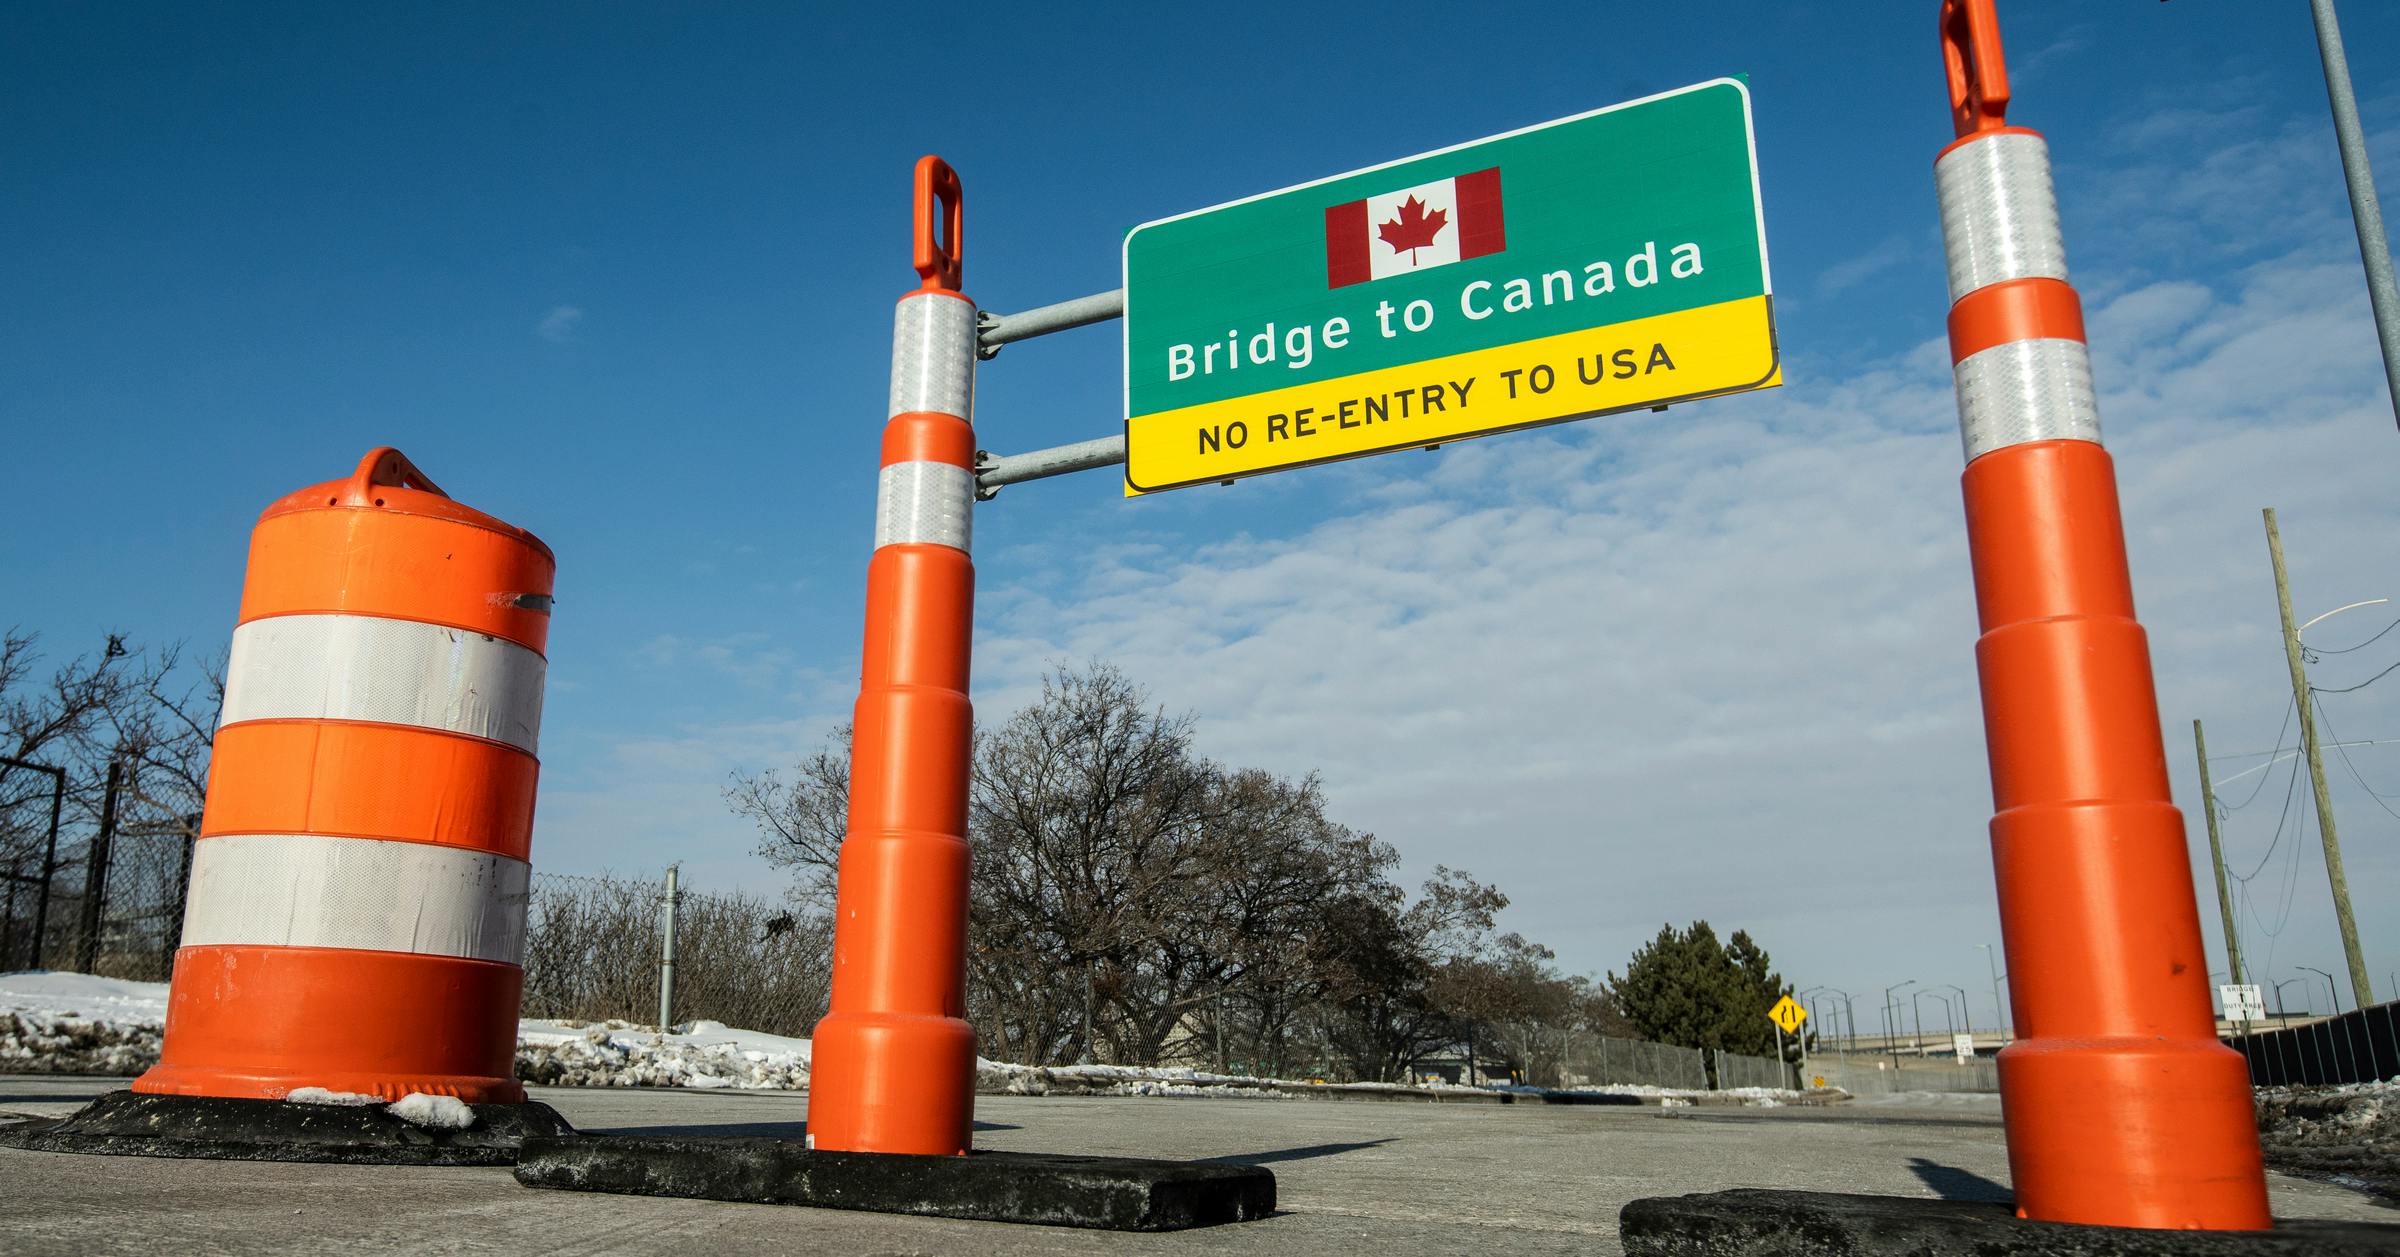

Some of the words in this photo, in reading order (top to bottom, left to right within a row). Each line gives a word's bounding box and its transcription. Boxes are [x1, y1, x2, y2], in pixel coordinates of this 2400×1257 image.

[1168, 322, 1350, 382] Bridge
[1375, 299, 1434, 338] to
[1460, 241, 1704, 320] Canada
[1199, 421, 1248, 455] NO
[1267, 377, 1477, 443] RE-ENTRY
[1500, 364, 1555, 399] TO
[1577, 343, 1676, 386] USA
